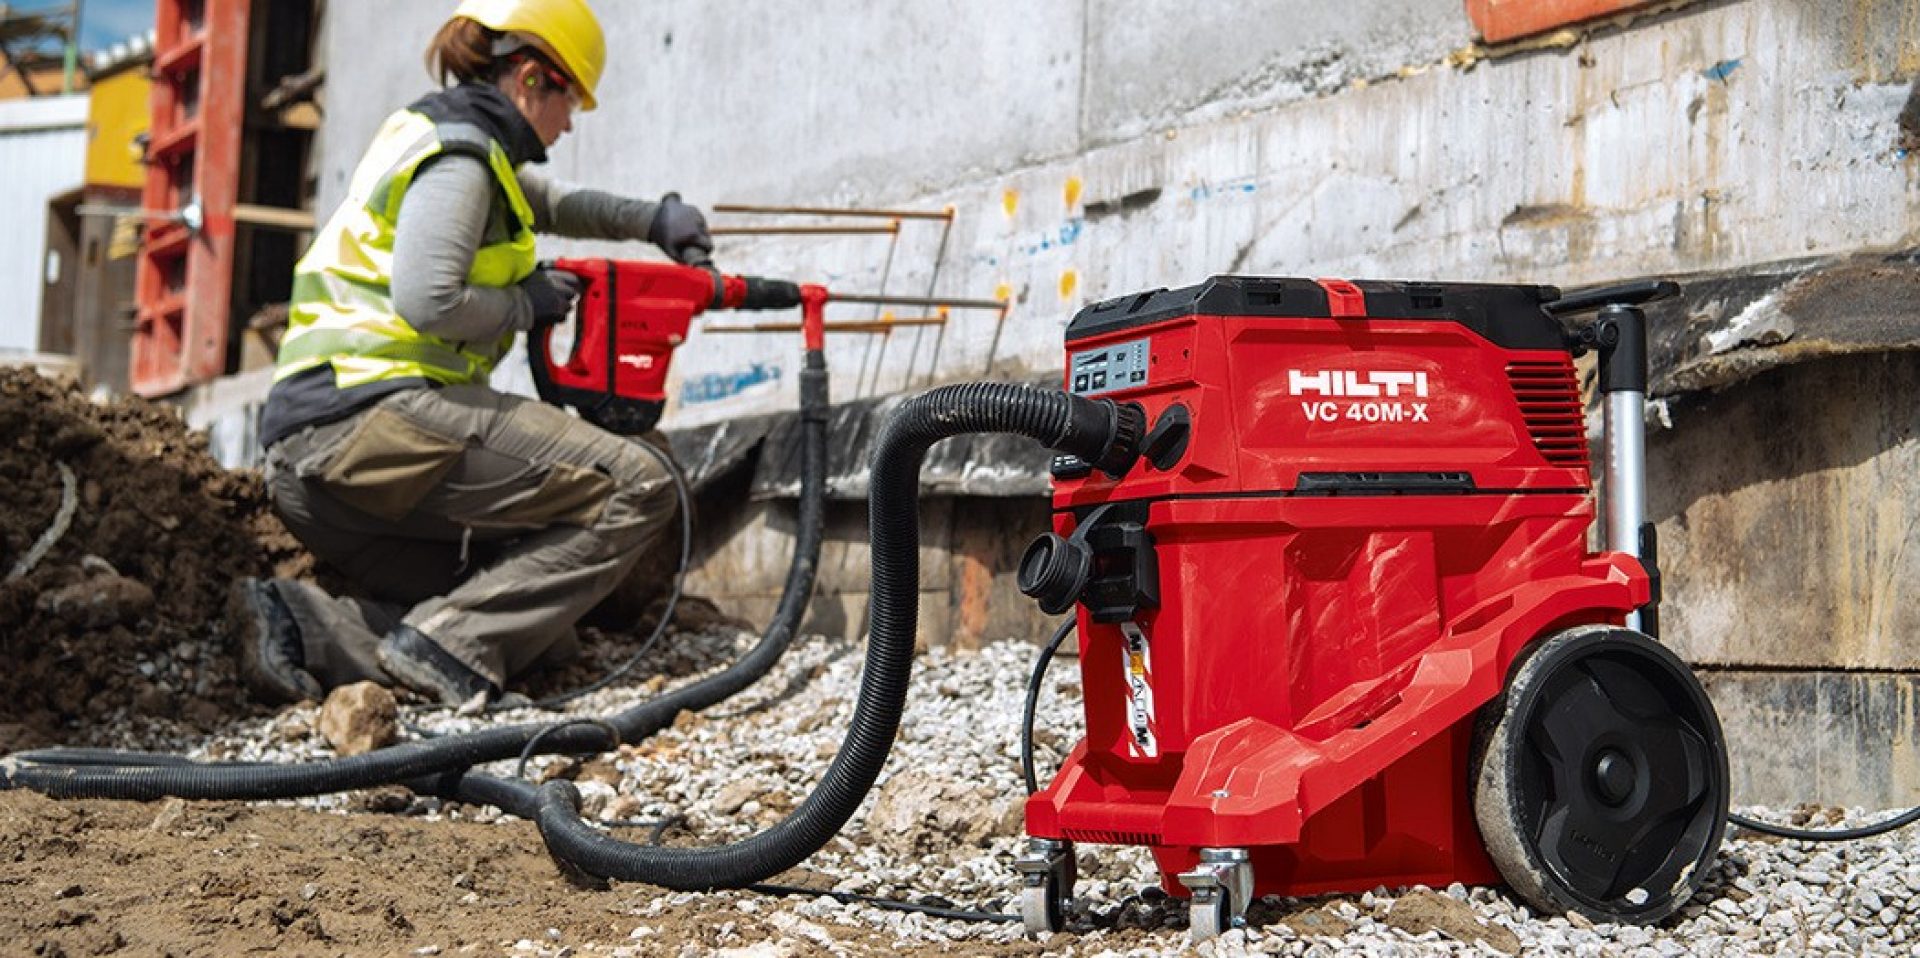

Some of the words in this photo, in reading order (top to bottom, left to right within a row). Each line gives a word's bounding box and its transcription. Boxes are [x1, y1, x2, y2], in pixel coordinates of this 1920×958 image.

[1289, 370, 1428, 397] HILTI
[1302, 402, 1339, 421] VC
[1346, 402, 1429, 422] 40M-X
